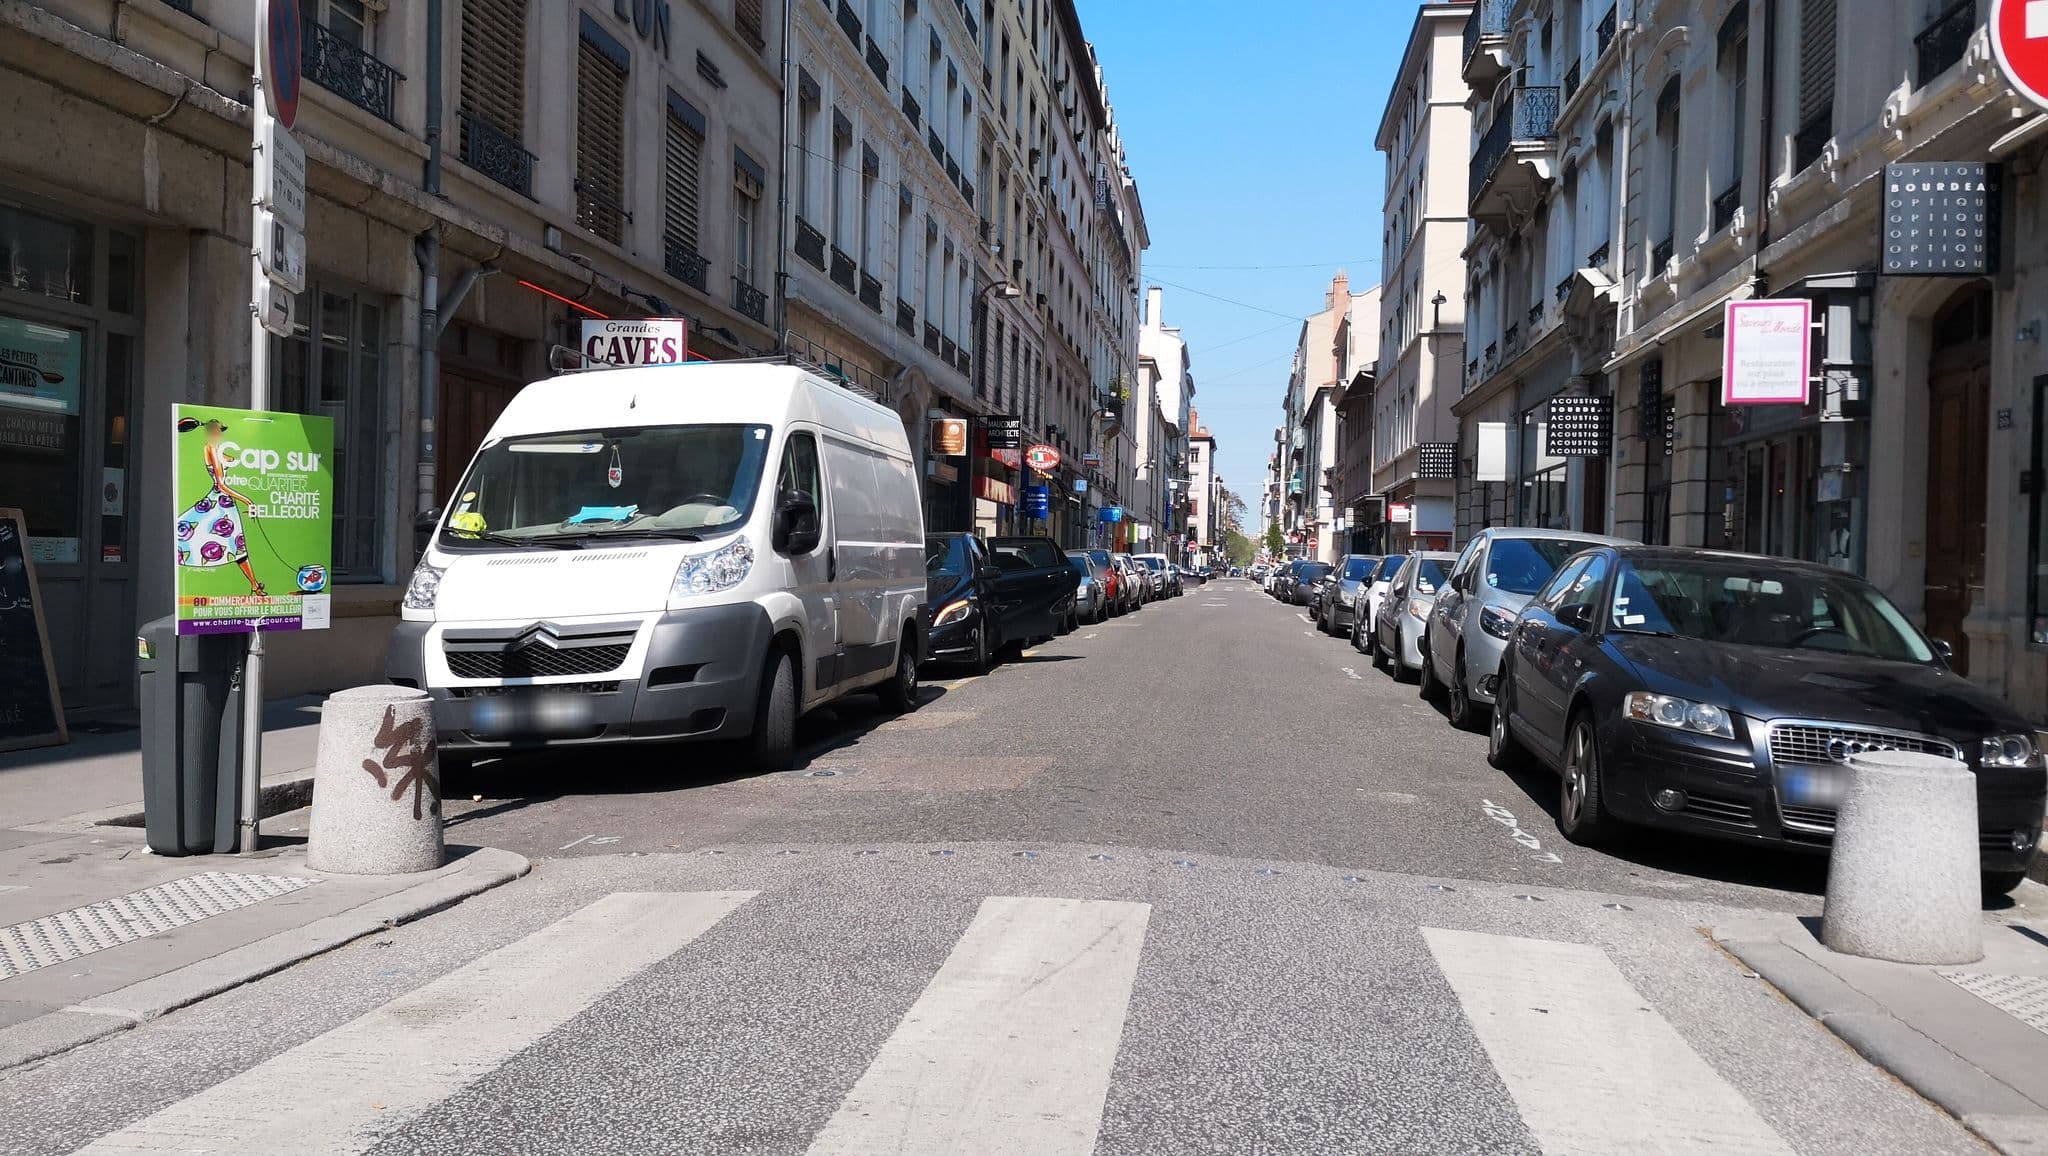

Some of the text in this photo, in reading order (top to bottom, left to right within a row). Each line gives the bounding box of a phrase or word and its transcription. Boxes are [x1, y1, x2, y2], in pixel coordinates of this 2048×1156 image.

[605, 322, 661, 333] Grandes
[11, 349, 38, 366] PETITES
[586, 335, 678, 365] CAVES
[217, 440, 322, 475] Cap sur
[247, 475, 308, 492] QUARTIER
[270, 489, 320, 506] CHARITÉ
[248, 503, 320, 520] BELLECOUR
[193, 596, 208, 607] 80
[193, 603, 302, 618] POUR VOUS OFFRIR LE MEILLEUR
[193, 616, 301, 628] www.charite-beecour.com
